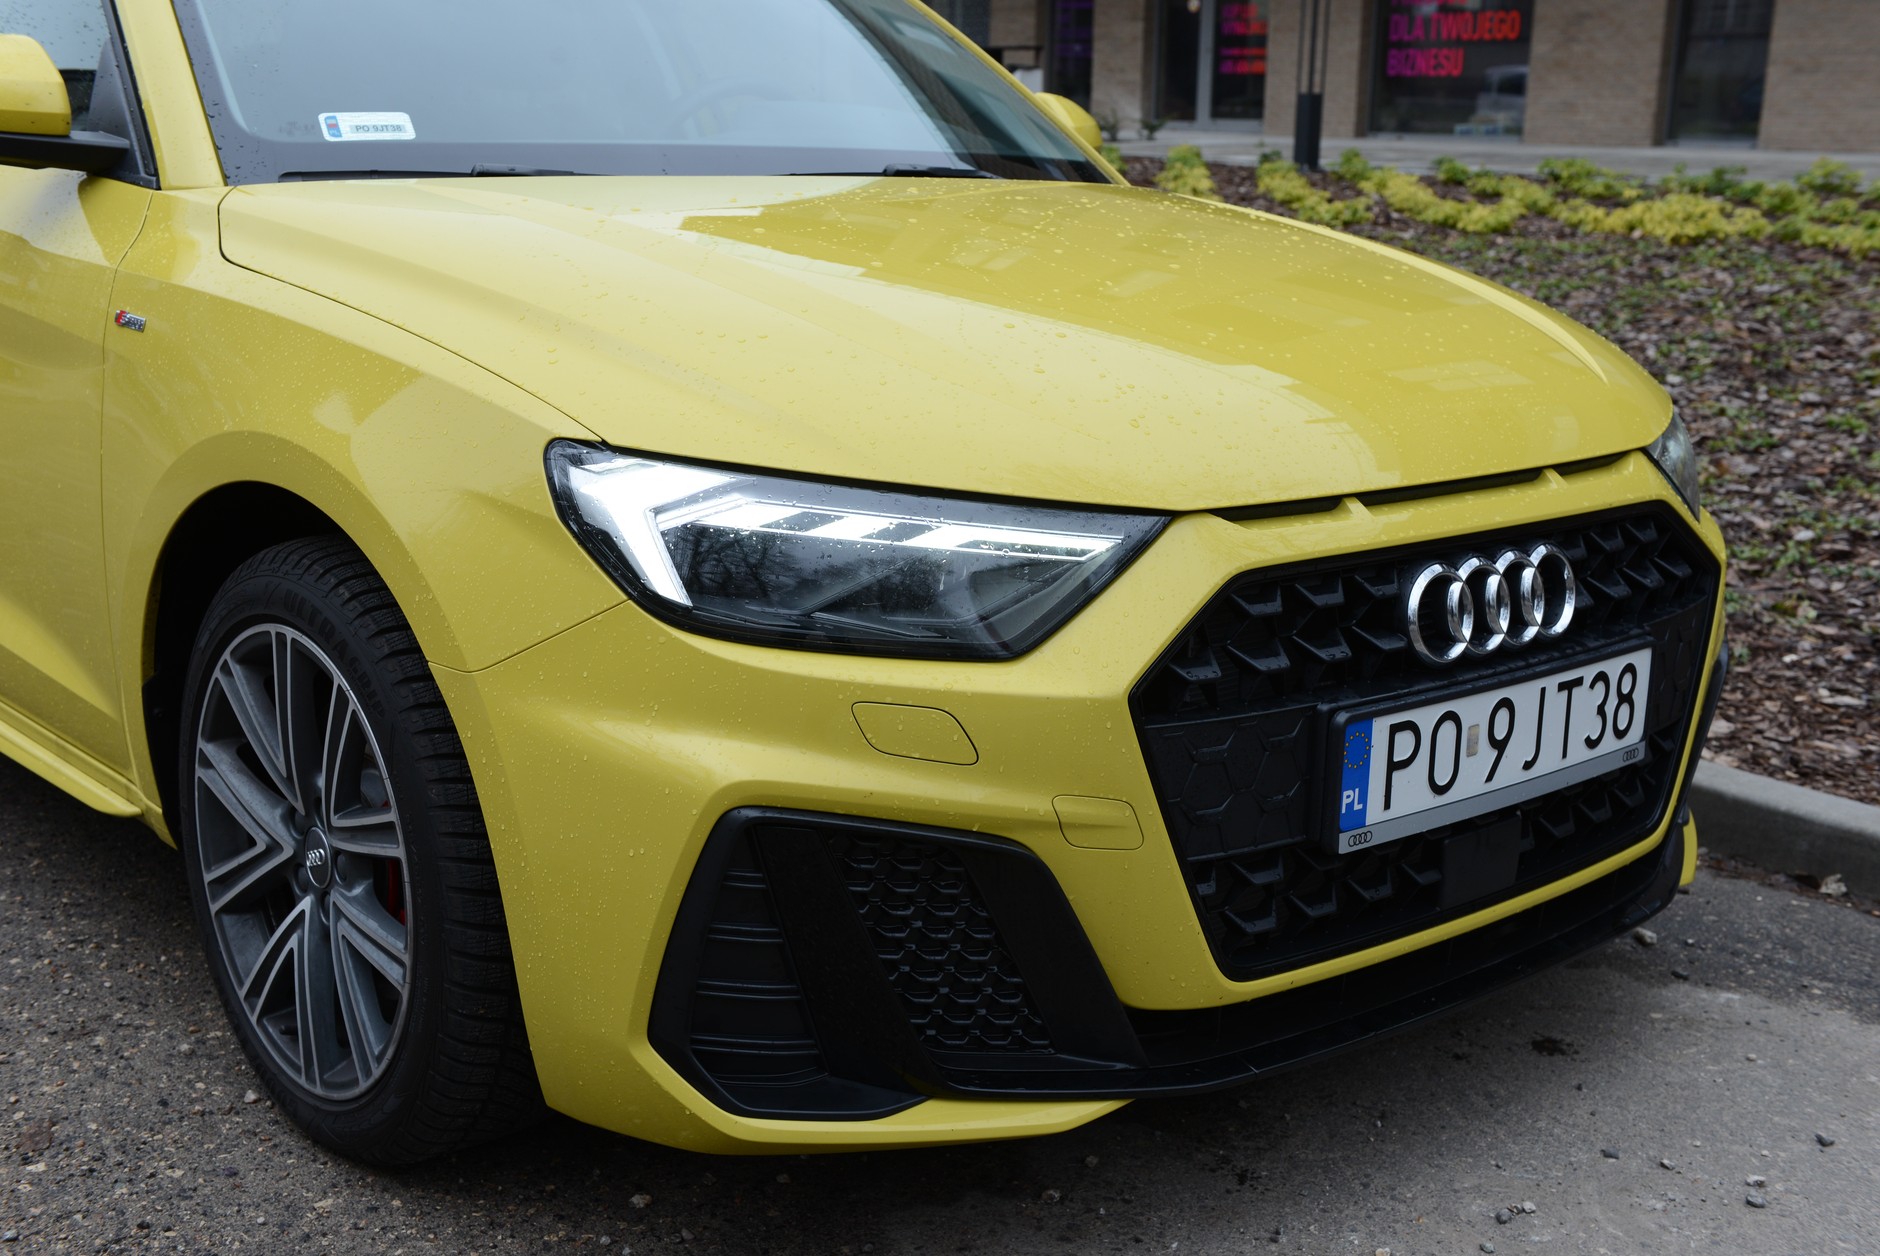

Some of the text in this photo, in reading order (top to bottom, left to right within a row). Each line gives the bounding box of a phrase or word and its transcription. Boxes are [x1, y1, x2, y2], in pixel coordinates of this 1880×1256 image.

[1389, 9, 1522, 41] DLA TWOJEGO
[1386, 47, 1465, 77] BIZNESU
[355, 124, 402, 132] PO 9JT38
[1383, 662, 1638, 811] PO 9JT38
[1341, 789, 1363, 814] PL
